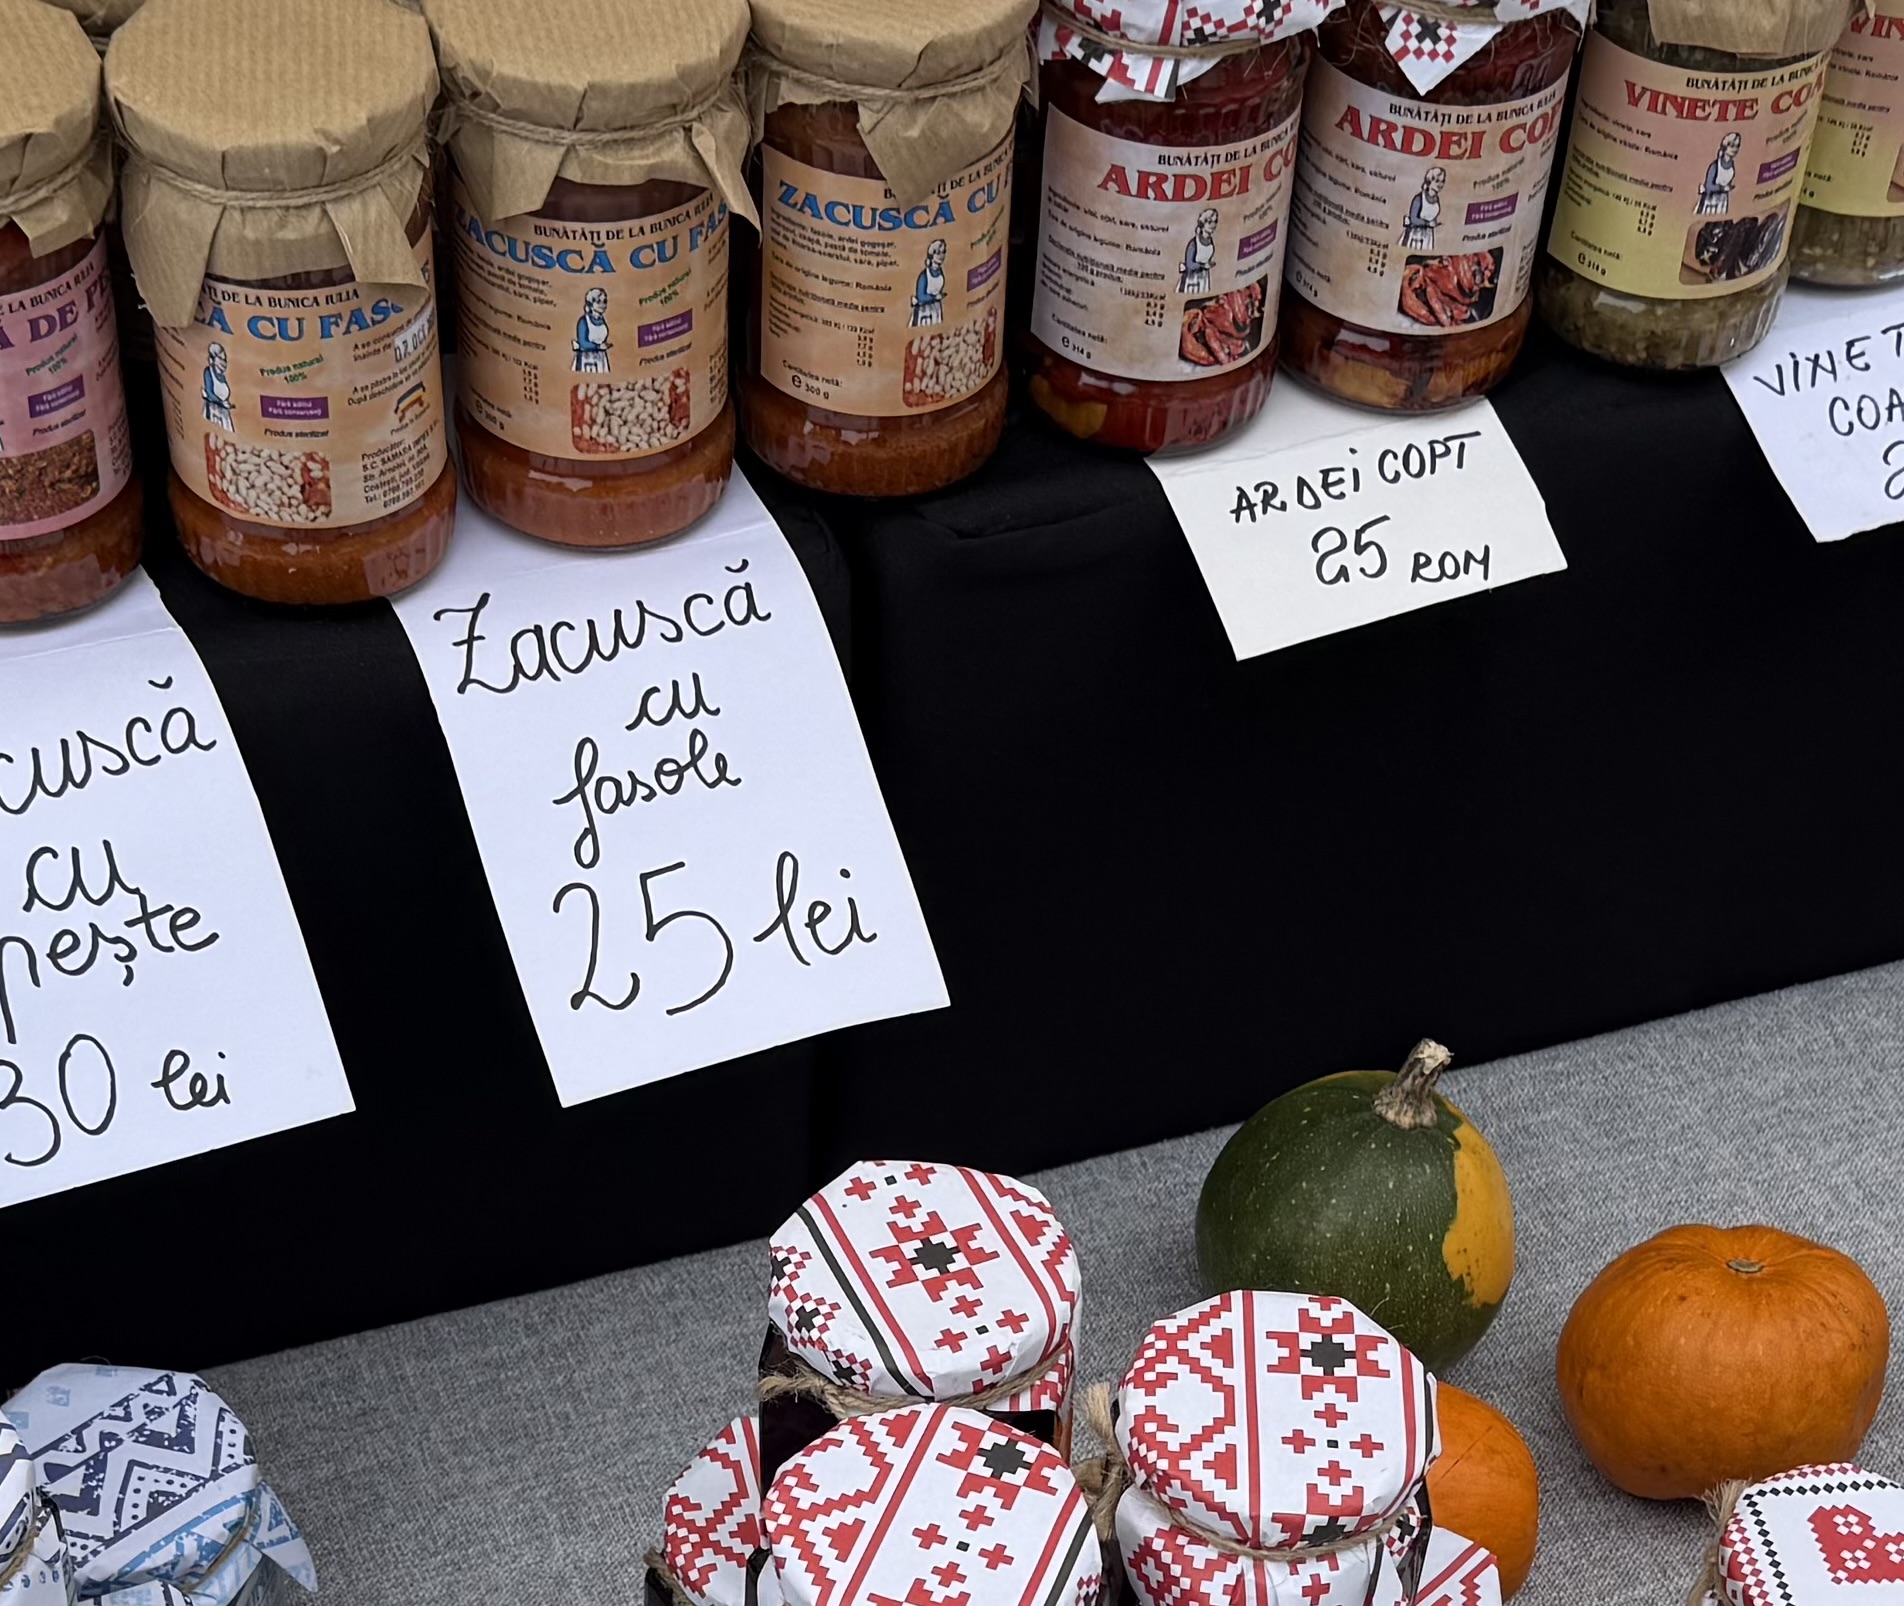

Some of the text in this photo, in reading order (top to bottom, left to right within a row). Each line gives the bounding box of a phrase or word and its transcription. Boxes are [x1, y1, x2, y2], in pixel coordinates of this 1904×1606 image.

[1624, 79, 1759, 122] VINETE
[1335, 105, 1487, 160] ARDEI
[777, 179, 955, 232] ZACUSCĂ
[1097, 163, 1253, 203] ARDEI
[629, 235, 682, 270] CU
[27, 300, 80, 344] DE
[247, 315, 306, 342] CU
[1375, 431, 1480, 487] COPT
[1311, 515, 1493, 586] 25 RON
[431, 559, 773, 698] Zacuscă
[625, 674, 721, 732] cu
[552, 737, 742, 868] fasole
[22, 837, 142, 912] cu
[552, 851, 877, 1016] 25 lei
[151, 1050, 231, 1113] lei
